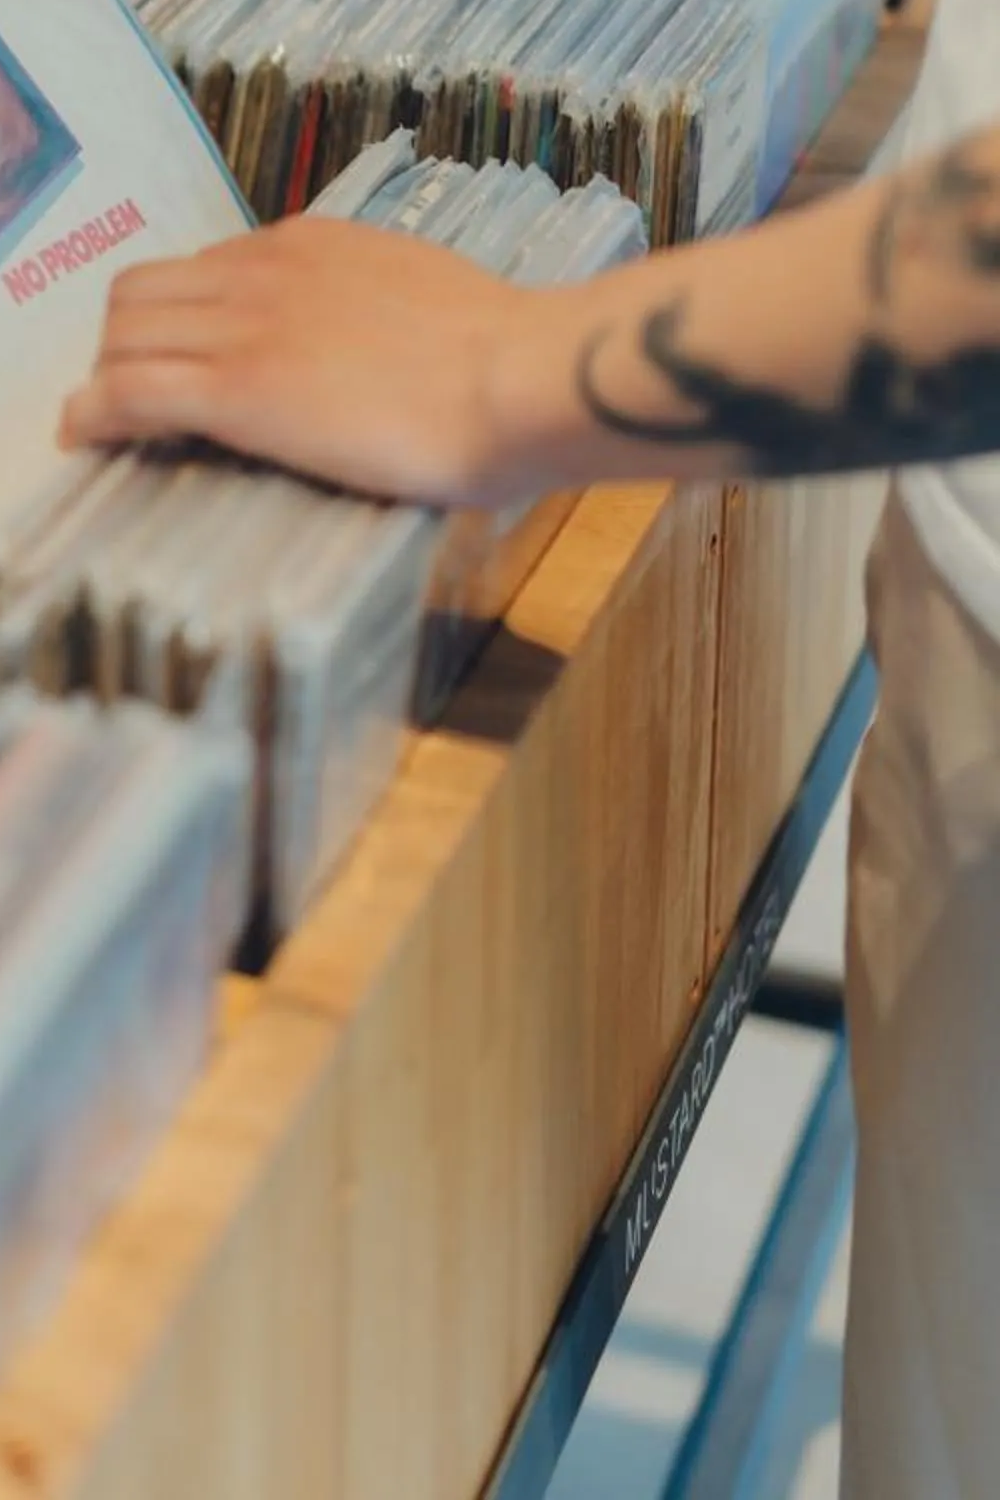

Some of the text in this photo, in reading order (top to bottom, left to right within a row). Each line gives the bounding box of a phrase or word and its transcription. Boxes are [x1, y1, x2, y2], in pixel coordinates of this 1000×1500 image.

[2, 197, 147, 308] NO PROBLEM
[624, 1035, 716, 1273] MUSTARD
